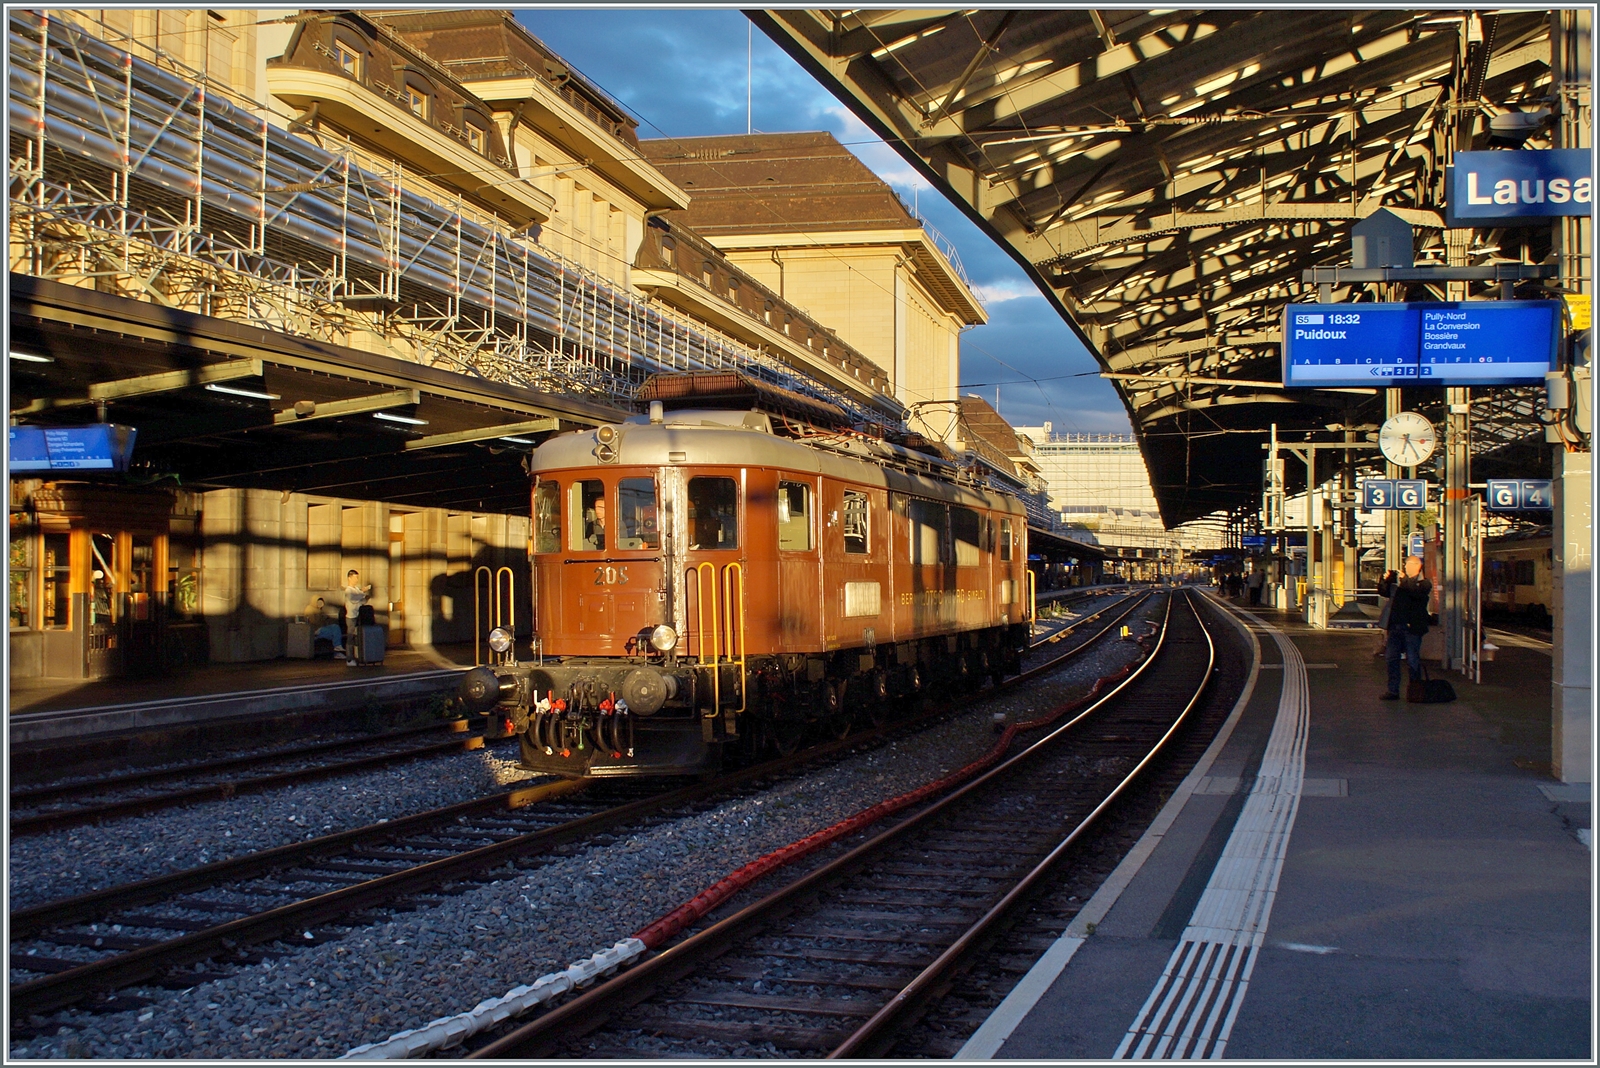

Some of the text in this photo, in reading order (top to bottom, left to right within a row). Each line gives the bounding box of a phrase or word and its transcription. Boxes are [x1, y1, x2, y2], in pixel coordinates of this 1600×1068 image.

[1467, 172, 1591, 205] Lausa
[1297, 314, 1360, 324] S5 18:32
[1425, 312, 1466, 321] Pully-Nord
[1436, 322, 1480, 330] Conversion
[1295, 329, 1347, 339] Puidoux
[1424, 332, 1459, 340] Bossière
[1424, 342, 1466, 350] Grandvaux
[1372, 489, 1418, 505] 3 G
[1496, 489, 1542, 505] G 4
[594, 566, 629, 585] 205
[921, 587, 965, 606] LÖTSCRG
